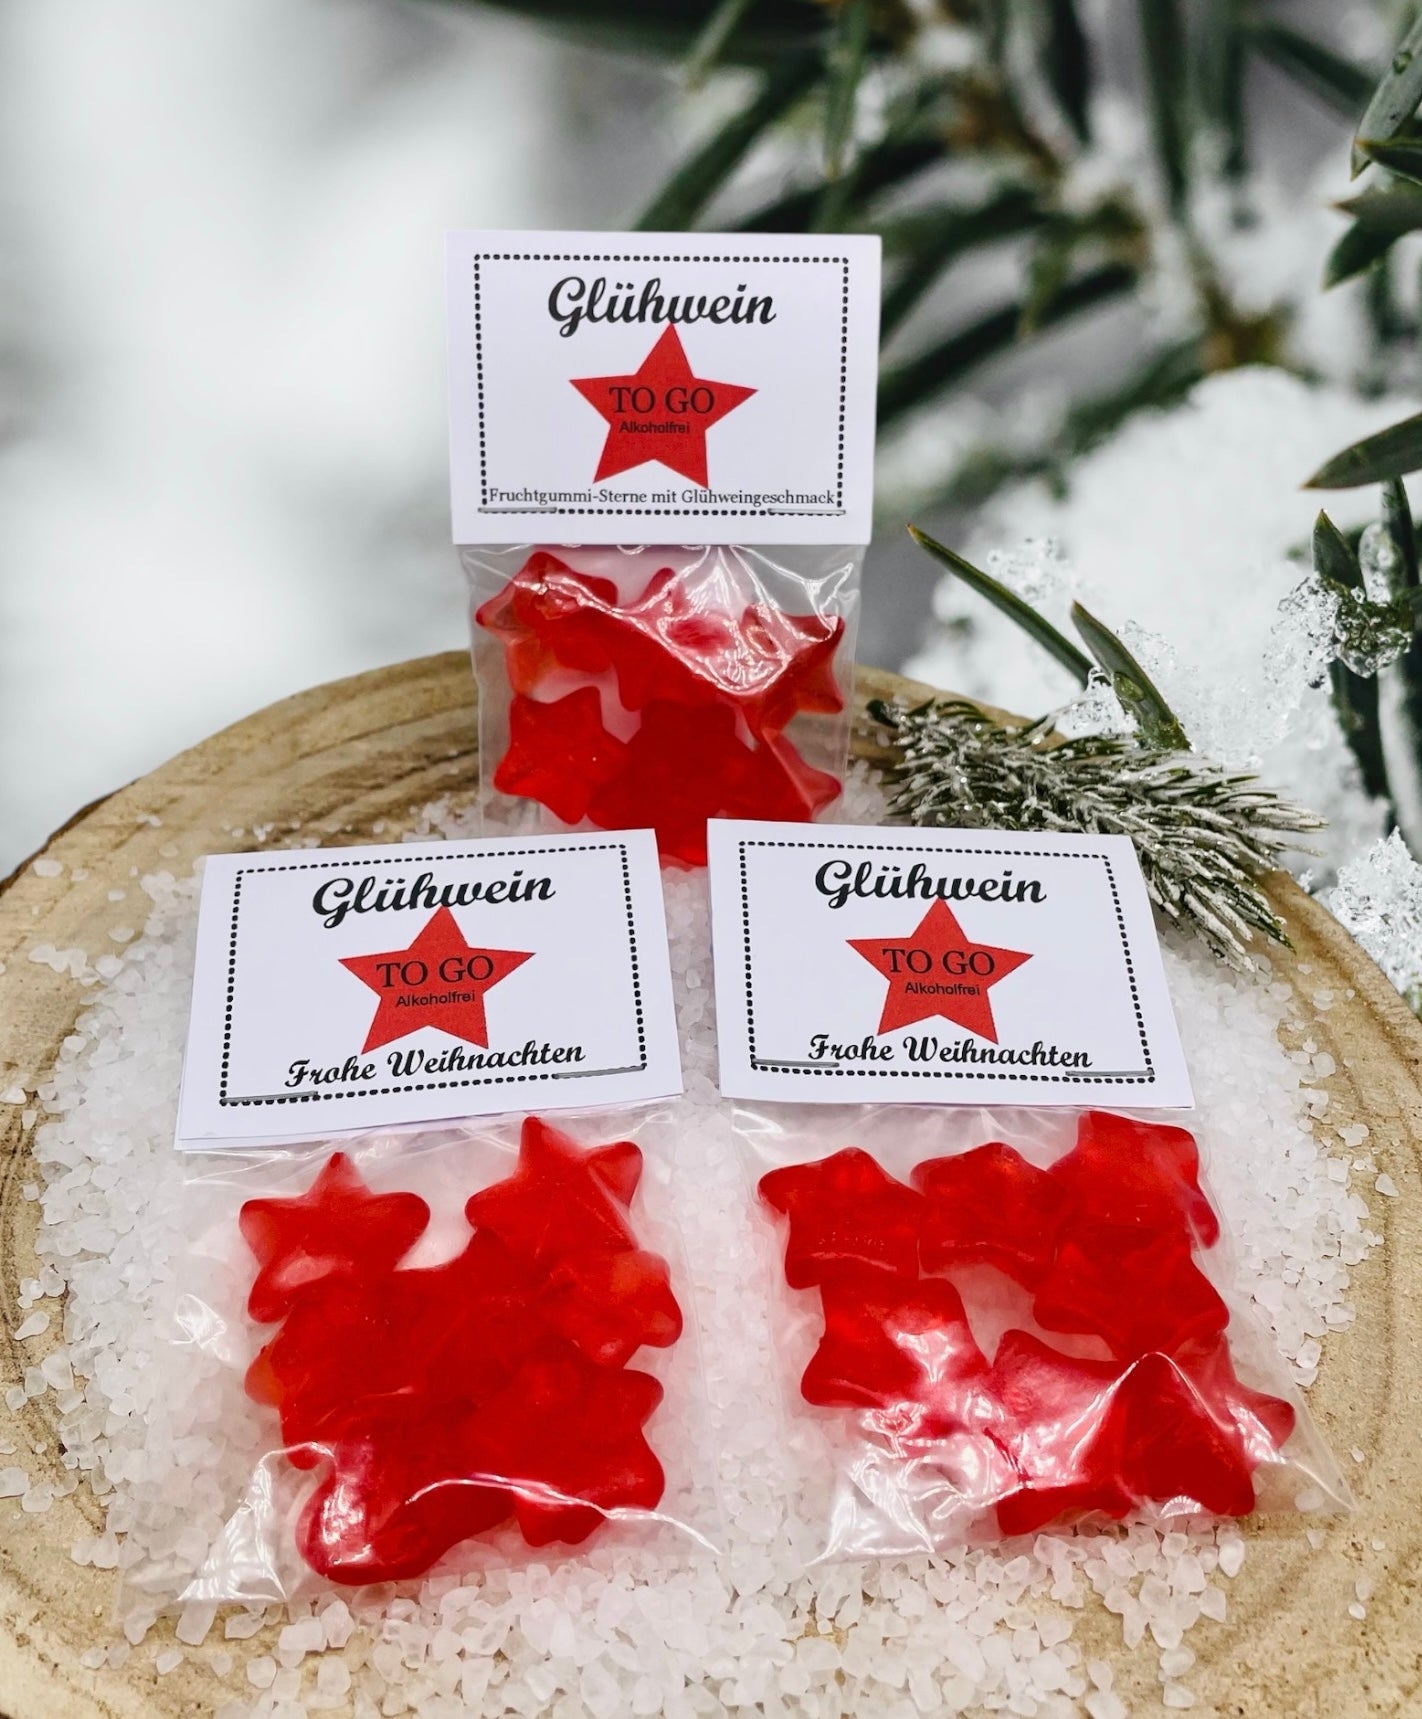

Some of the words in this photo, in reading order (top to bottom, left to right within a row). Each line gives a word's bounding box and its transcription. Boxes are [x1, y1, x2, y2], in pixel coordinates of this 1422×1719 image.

[547, 276, 777, 338] Glühwein
[609, 387, 655, 414] TO
[665, 387, 715, 414] GO
[619, 420, 690, 434] Alkoholfrei
[489, 488, 647, 505] Fruchtgummi-Sterne
[651, 490, 677, 504] mit
[681, 489, 835, 507] Glühweingeschmack
[814, 859, 1047, 909] Glühwein
[312, 870, 556, 929] Glühwein
[376, 961, 429, 988] TO
[439, 955, 495, 983] GO
[882, 948, 933, 974] TO
[942, 950, 995, 976] GO
[395, 990, 476, 1008] Alkoholfrei
[904, 981, 981, 996] Alkoholfrei
[284, 1057, 377, 1088] Frohe
[387, 1039, 586, 1078] Weihnachten
[808, 1033, 895, 1062] Frohe
[902, 1036, 1092, 1069] Weihnachten
